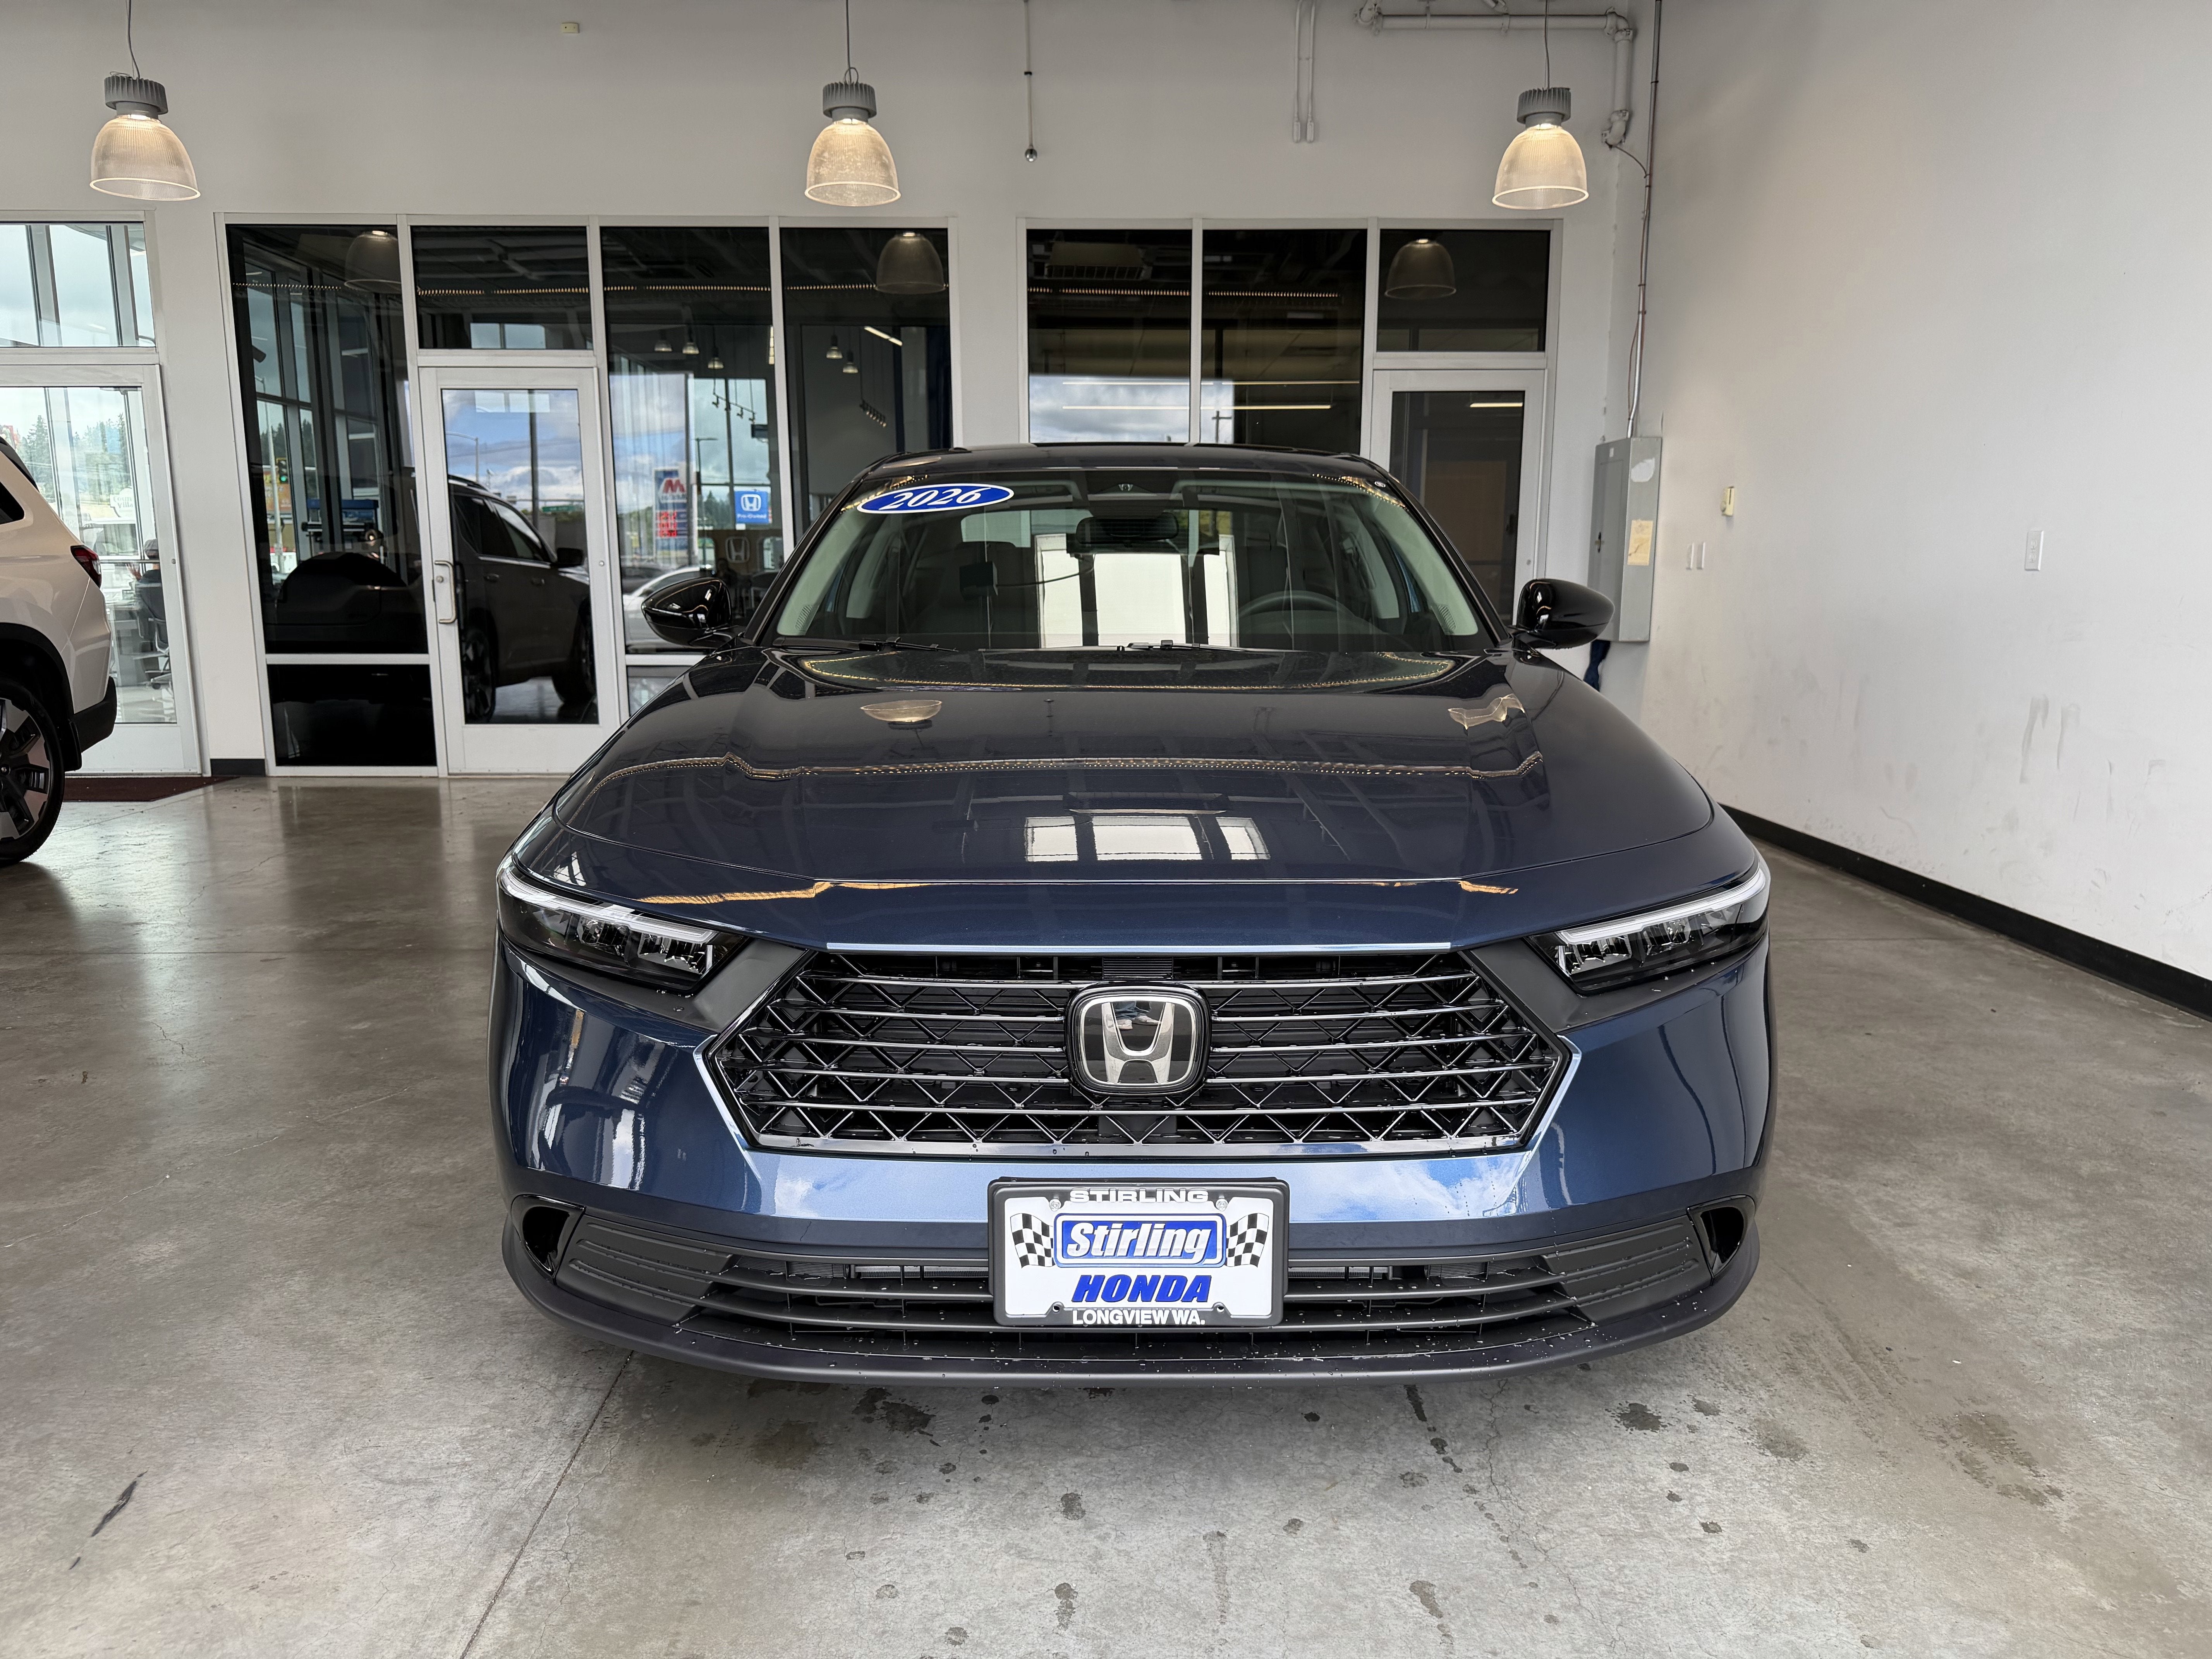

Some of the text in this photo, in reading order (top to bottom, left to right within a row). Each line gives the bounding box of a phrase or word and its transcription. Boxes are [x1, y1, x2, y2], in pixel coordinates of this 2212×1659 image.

[878, 487, 991, 510] 2026
[1070, 1188, 1209, 1203] STIRLING
[1068, 1222, 1212, 1264] Stirling
[1071, 1274, 1212, 1303] HONDA
[1072, 1309, 1206, 1325] LONGVIEW WA.
